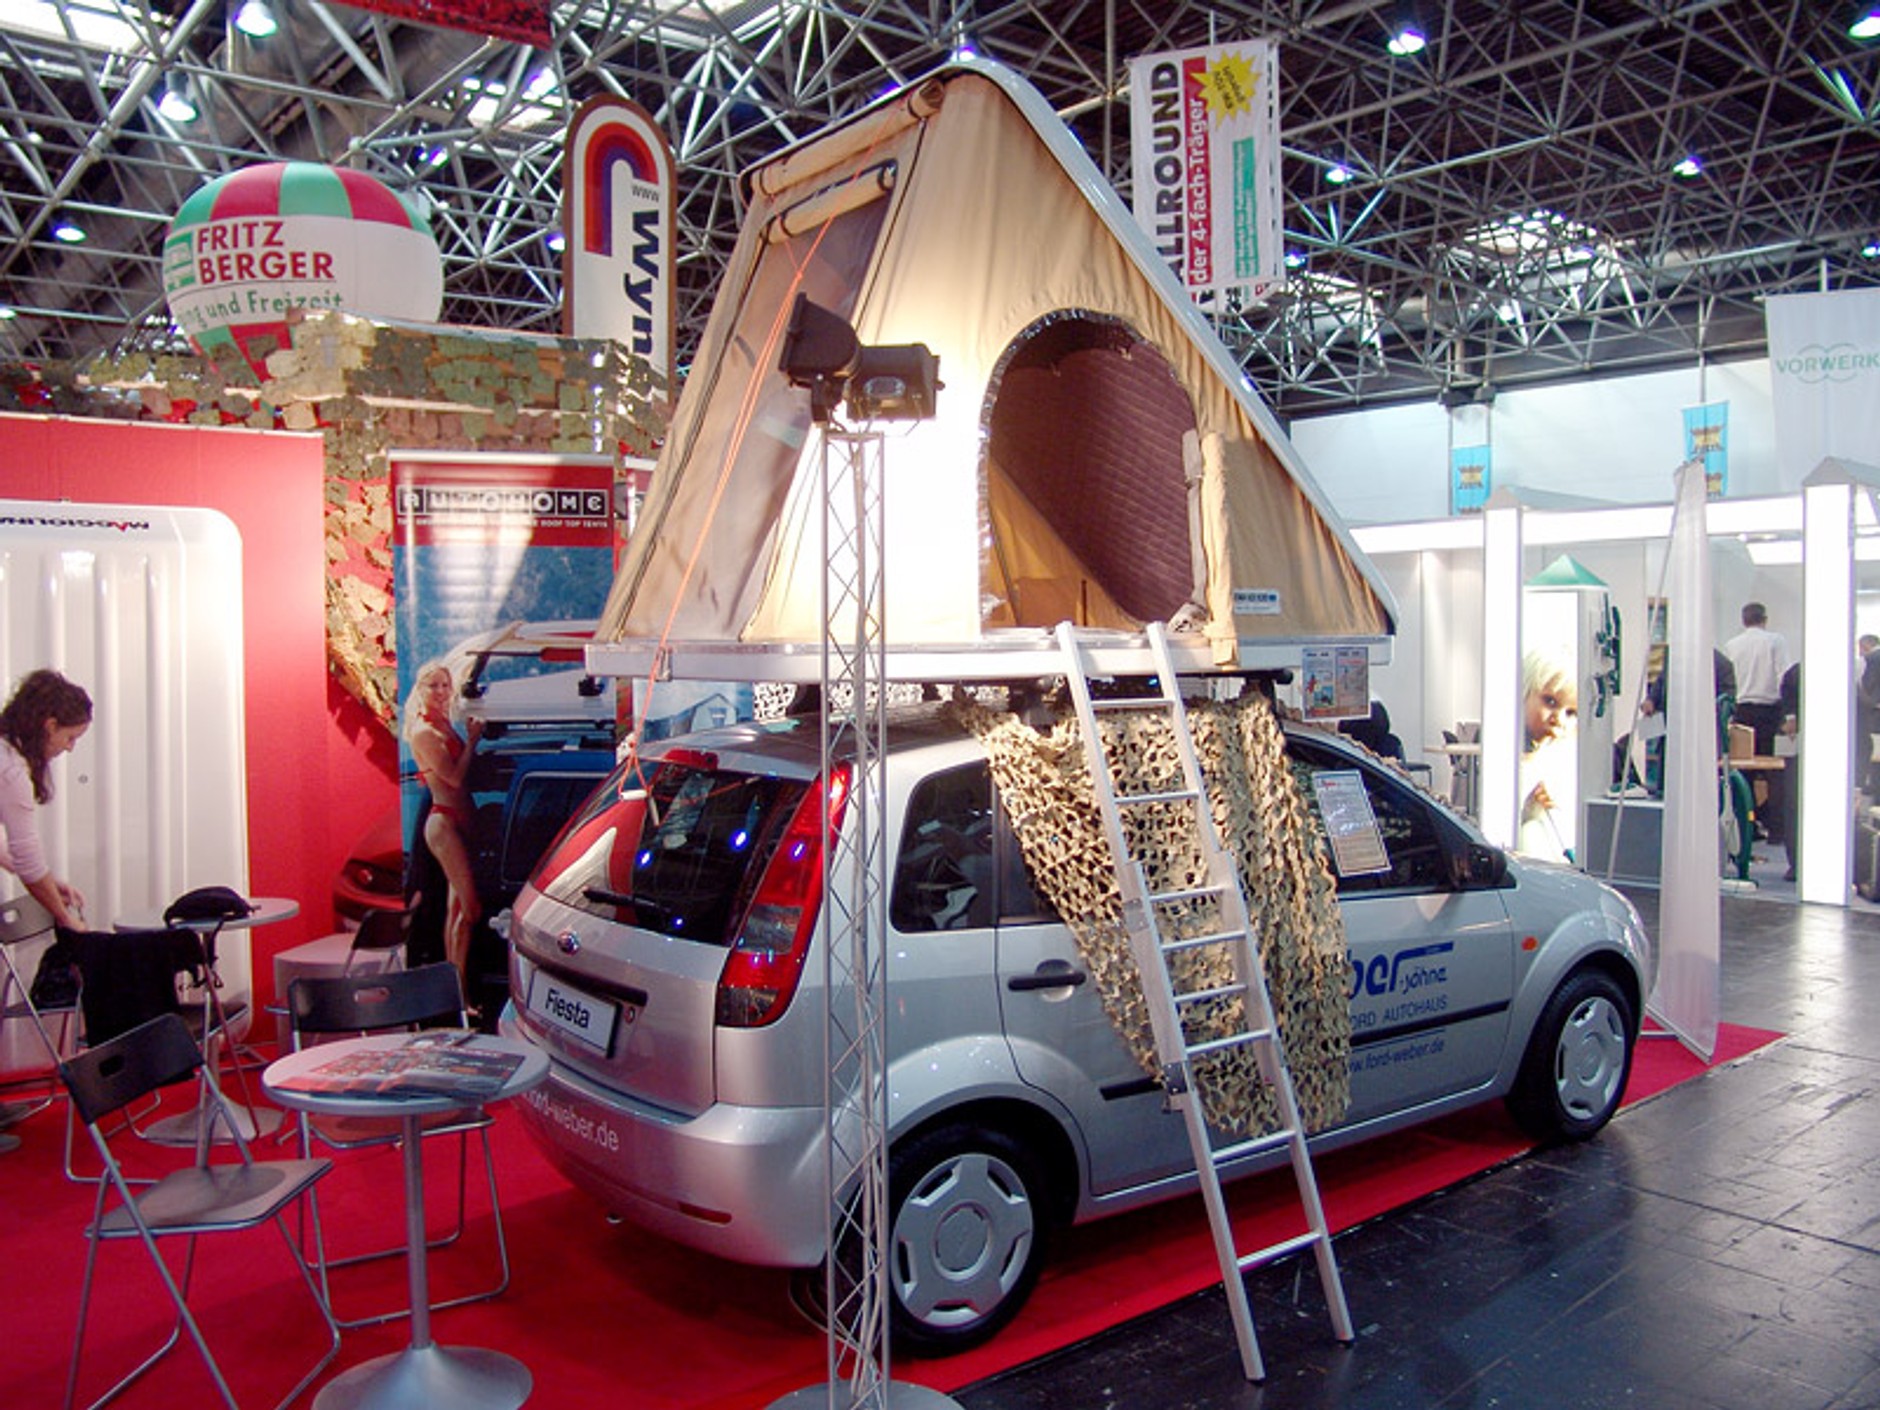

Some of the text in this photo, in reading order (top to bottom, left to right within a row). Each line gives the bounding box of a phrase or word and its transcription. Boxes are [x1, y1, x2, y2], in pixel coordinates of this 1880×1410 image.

[1188, 98, 1208, 283] der 4-fach-Träger
[197, 221, 285, 254] FRITZ
[199, 251, 335, 285] BERGER
[206, 291, 242, 318] und
[247, 289, 344, 314] Freizeit
[1776, 352, 1880, 375] VORWERK
[545, 987, 590, 1029] Fiesta
[1382, 994, 1448, 1023] AUTOHAUS
